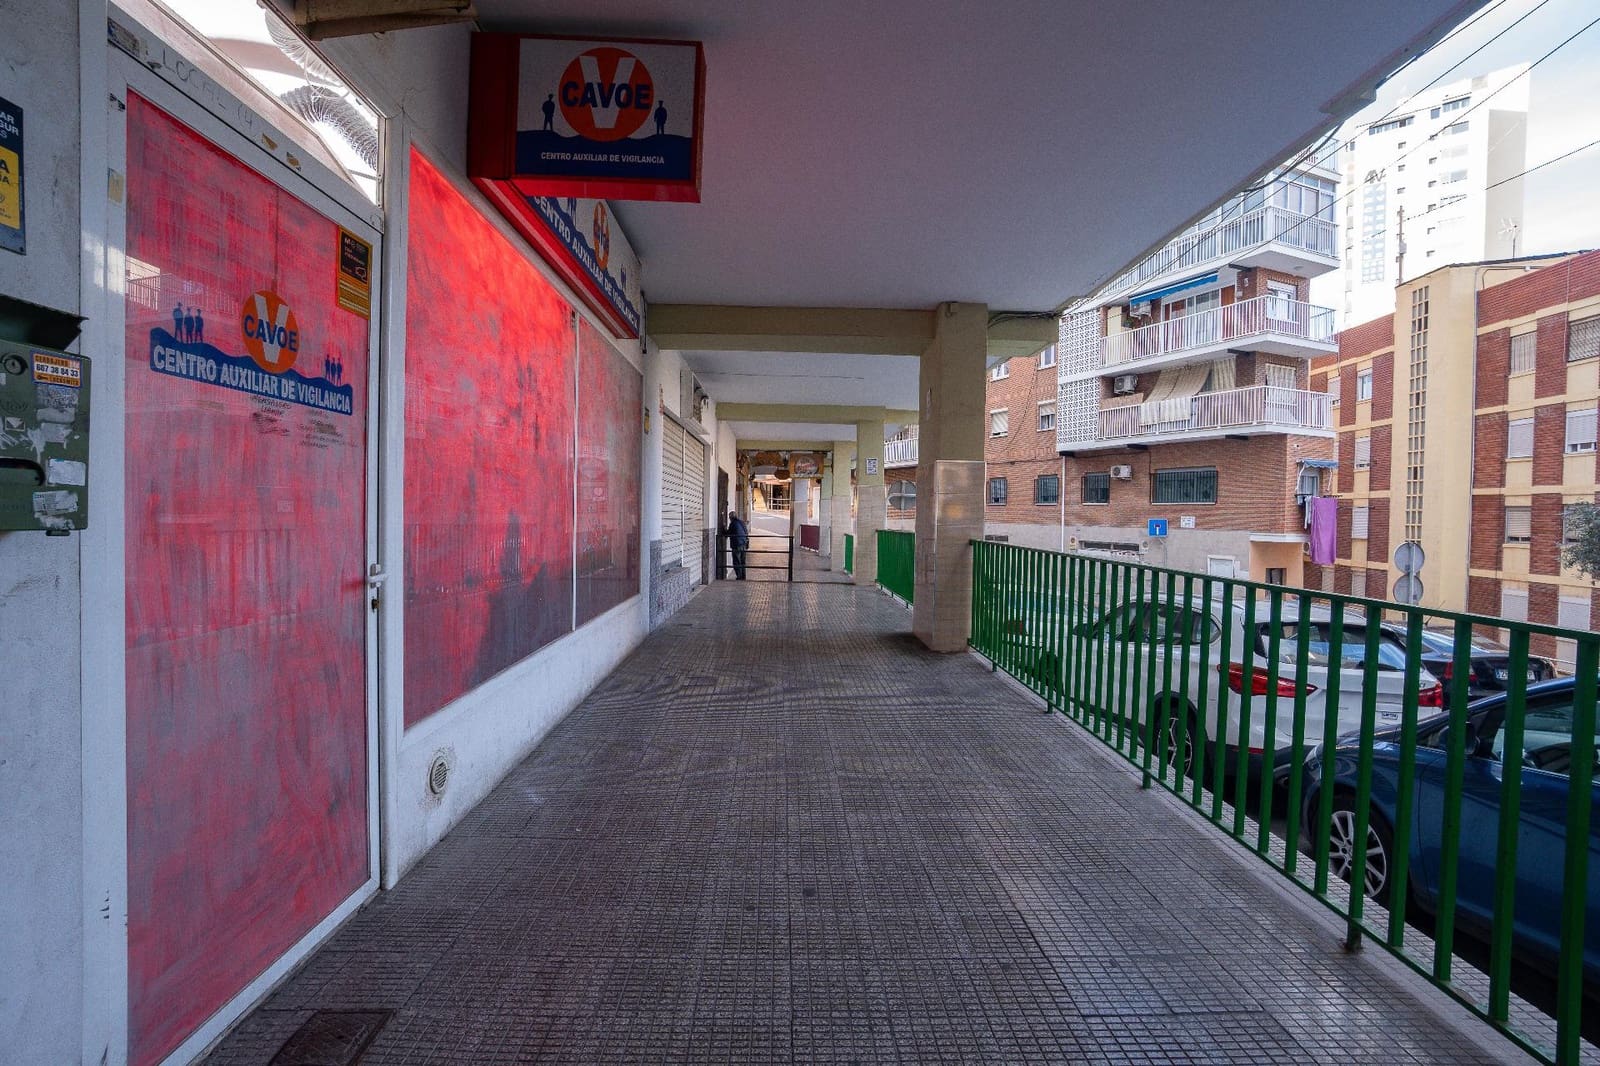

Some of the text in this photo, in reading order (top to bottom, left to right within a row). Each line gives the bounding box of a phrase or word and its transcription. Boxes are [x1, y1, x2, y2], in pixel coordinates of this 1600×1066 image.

[561, 81, 651, 110] CAVOE
[540, 151, 664, 165] CENTRO AUXILIAR DE VIGILANCIA
[572, 238, 604, 284] AUXILIAR
[243, 315, 299, 353] CAVOE
[153, 345, 217, 380] CENTRO
[220, 363, 278, 397] AUXILIAR
[281, 378, 297, 401] DE
[297, 383, 352, 414] VIGILANCIA
